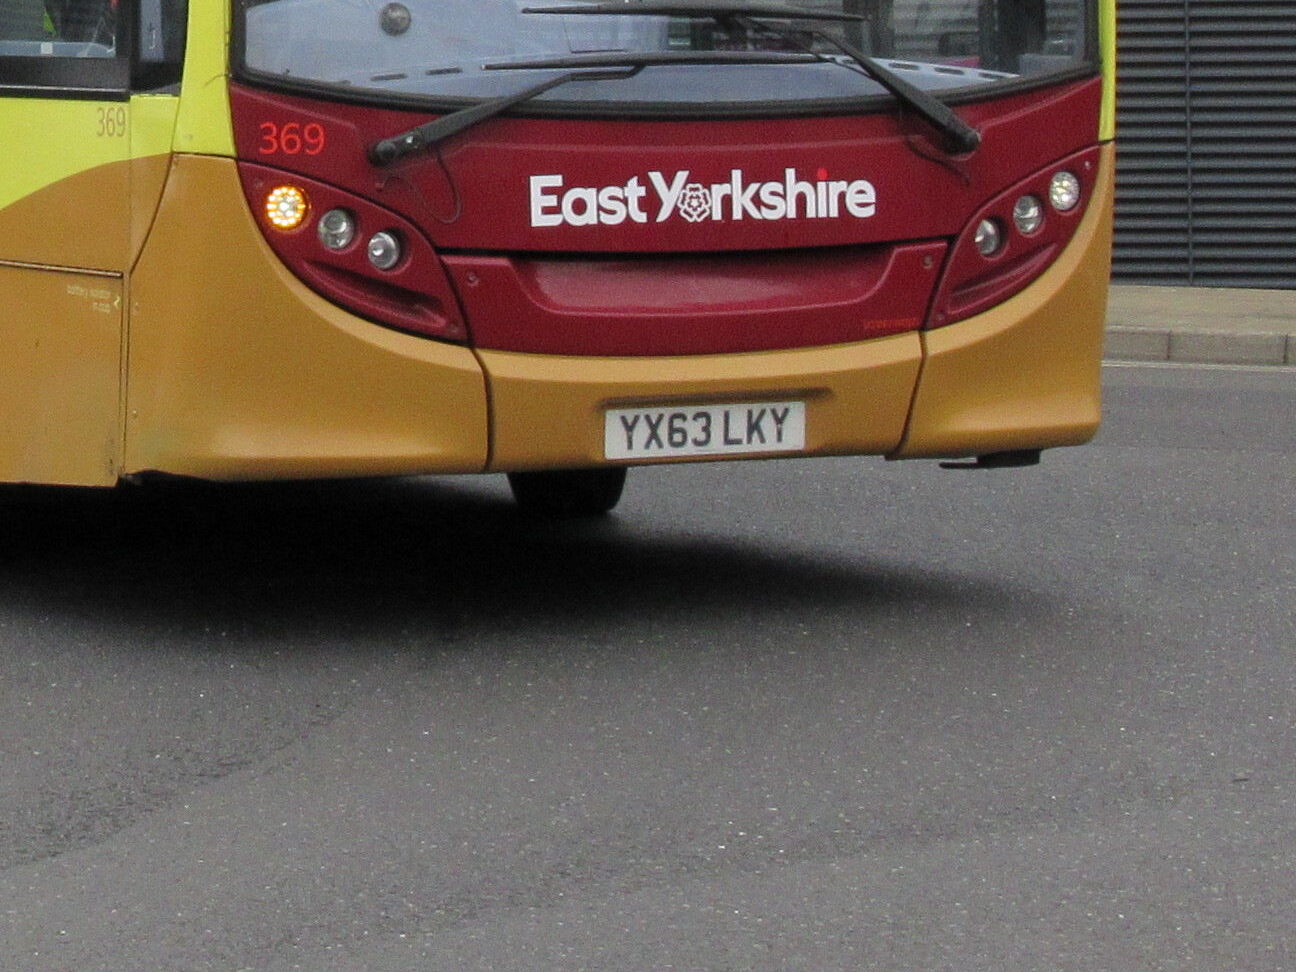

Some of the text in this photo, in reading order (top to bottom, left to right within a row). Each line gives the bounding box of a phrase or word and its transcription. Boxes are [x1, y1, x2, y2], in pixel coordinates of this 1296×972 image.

[96, 106, 127, 138] 369
[258, 121, 326, 155] 369
[529, 173, 648, 228] East
[619, 407, 790, 451] YX63 LKY
